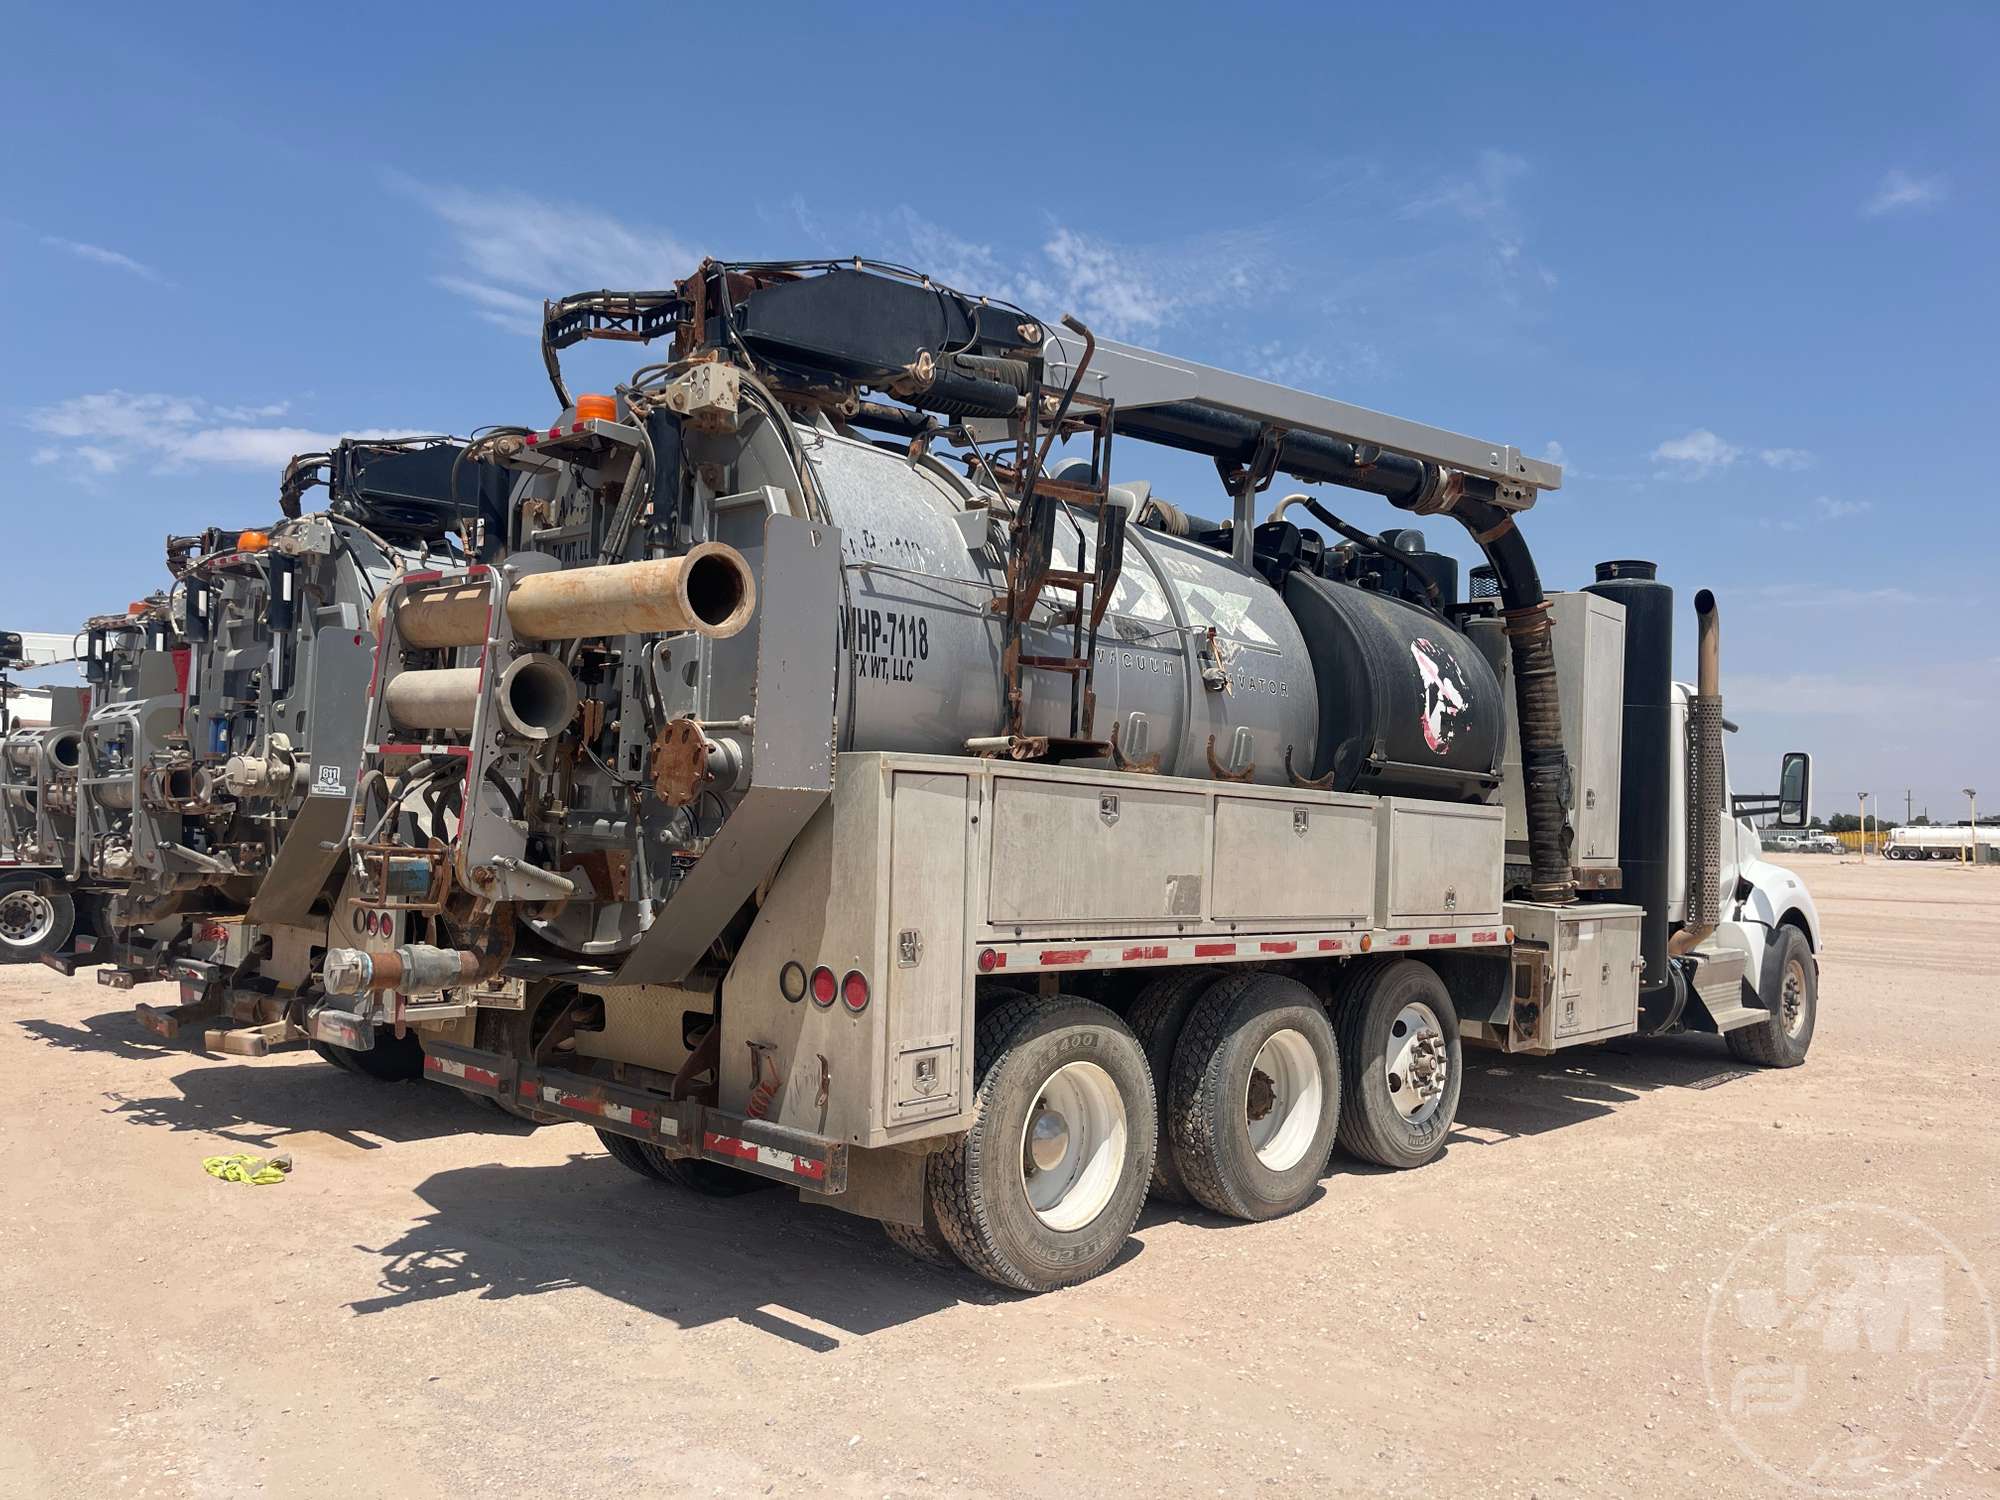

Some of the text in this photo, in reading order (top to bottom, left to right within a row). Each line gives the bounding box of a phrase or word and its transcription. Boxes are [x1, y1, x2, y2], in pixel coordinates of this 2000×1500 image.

[839, 604, 929, 661] WHP-7118
[870, 655, 889, 686] WT,
[893, 658, 914, 682] LLC
[1095, 647, 1173, 676] VACUUM
[322, 767, 337, 779] 811
